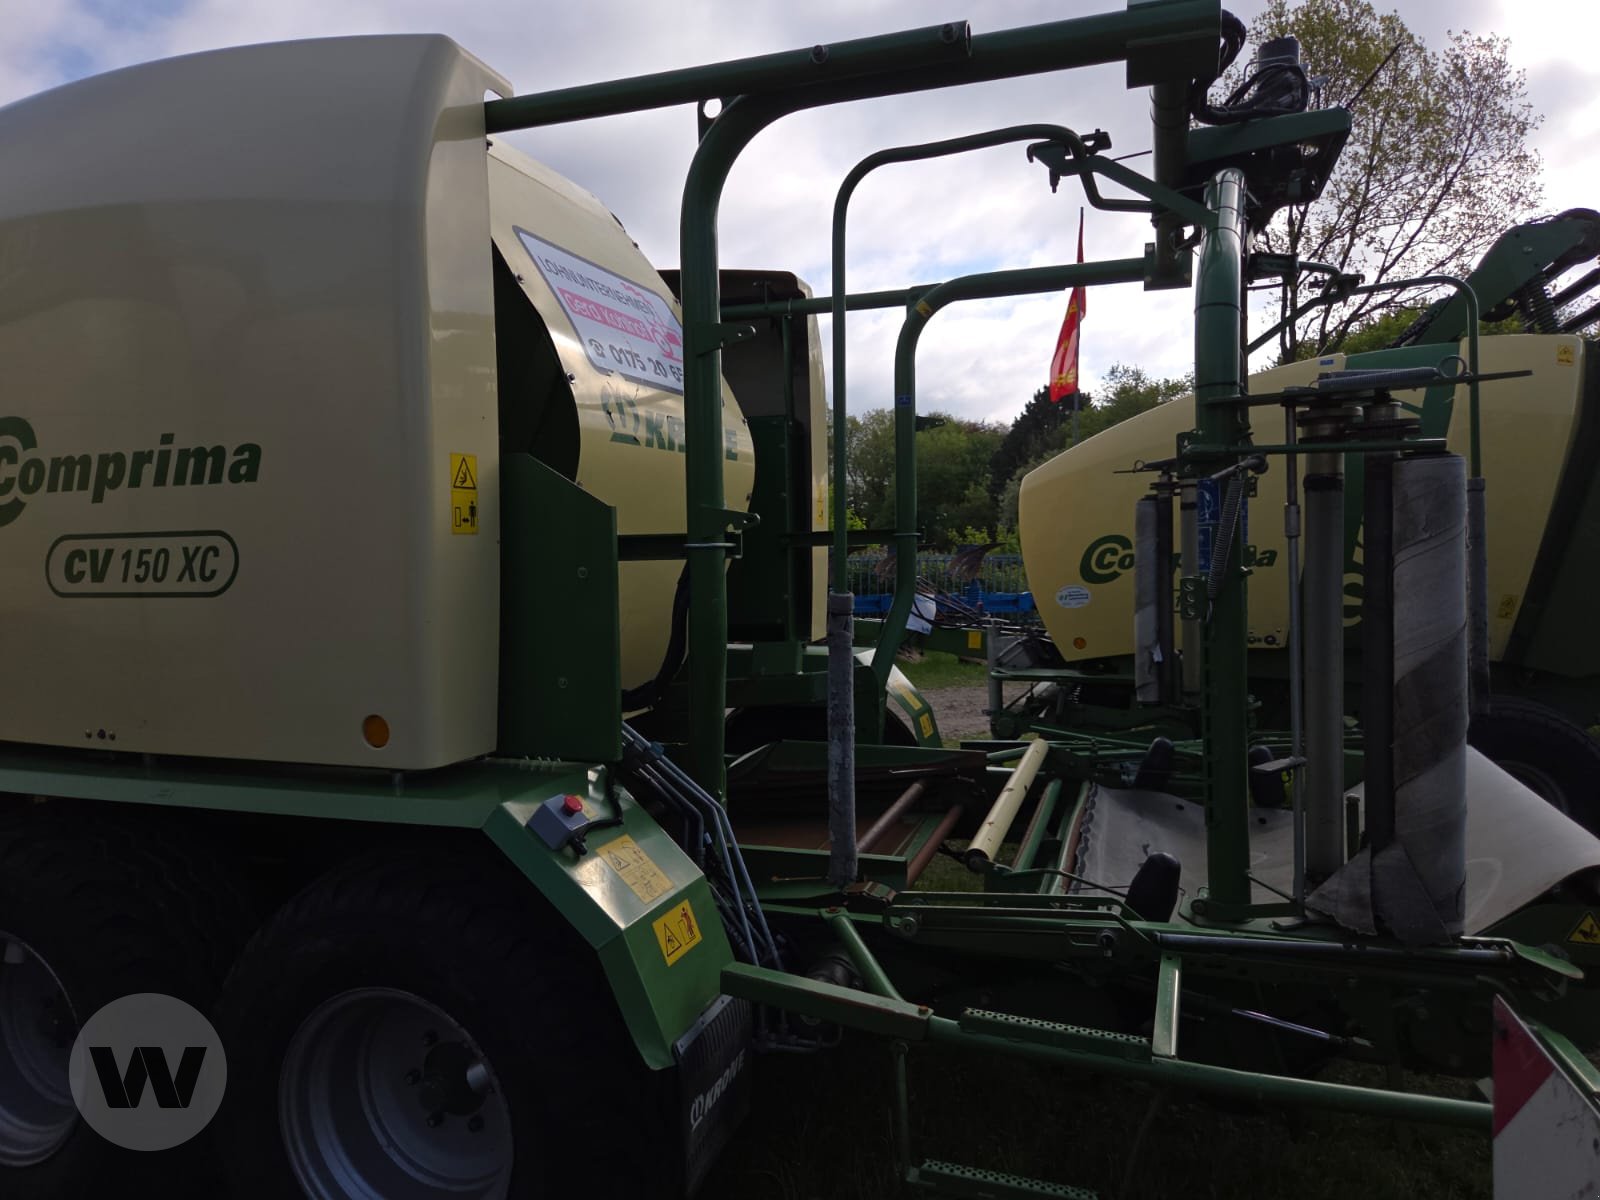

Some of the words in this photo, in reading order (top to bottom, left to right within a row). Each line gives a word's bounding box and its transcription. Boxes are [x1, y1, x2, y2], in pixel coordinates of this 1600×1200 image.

[609, 344, 646, 372] 0175
[647, 357, 668, 379] 20
[65, 548, 114, 584] CV
[121, 546, 169, 584] 150
[176, 544, 221, 583] XC
